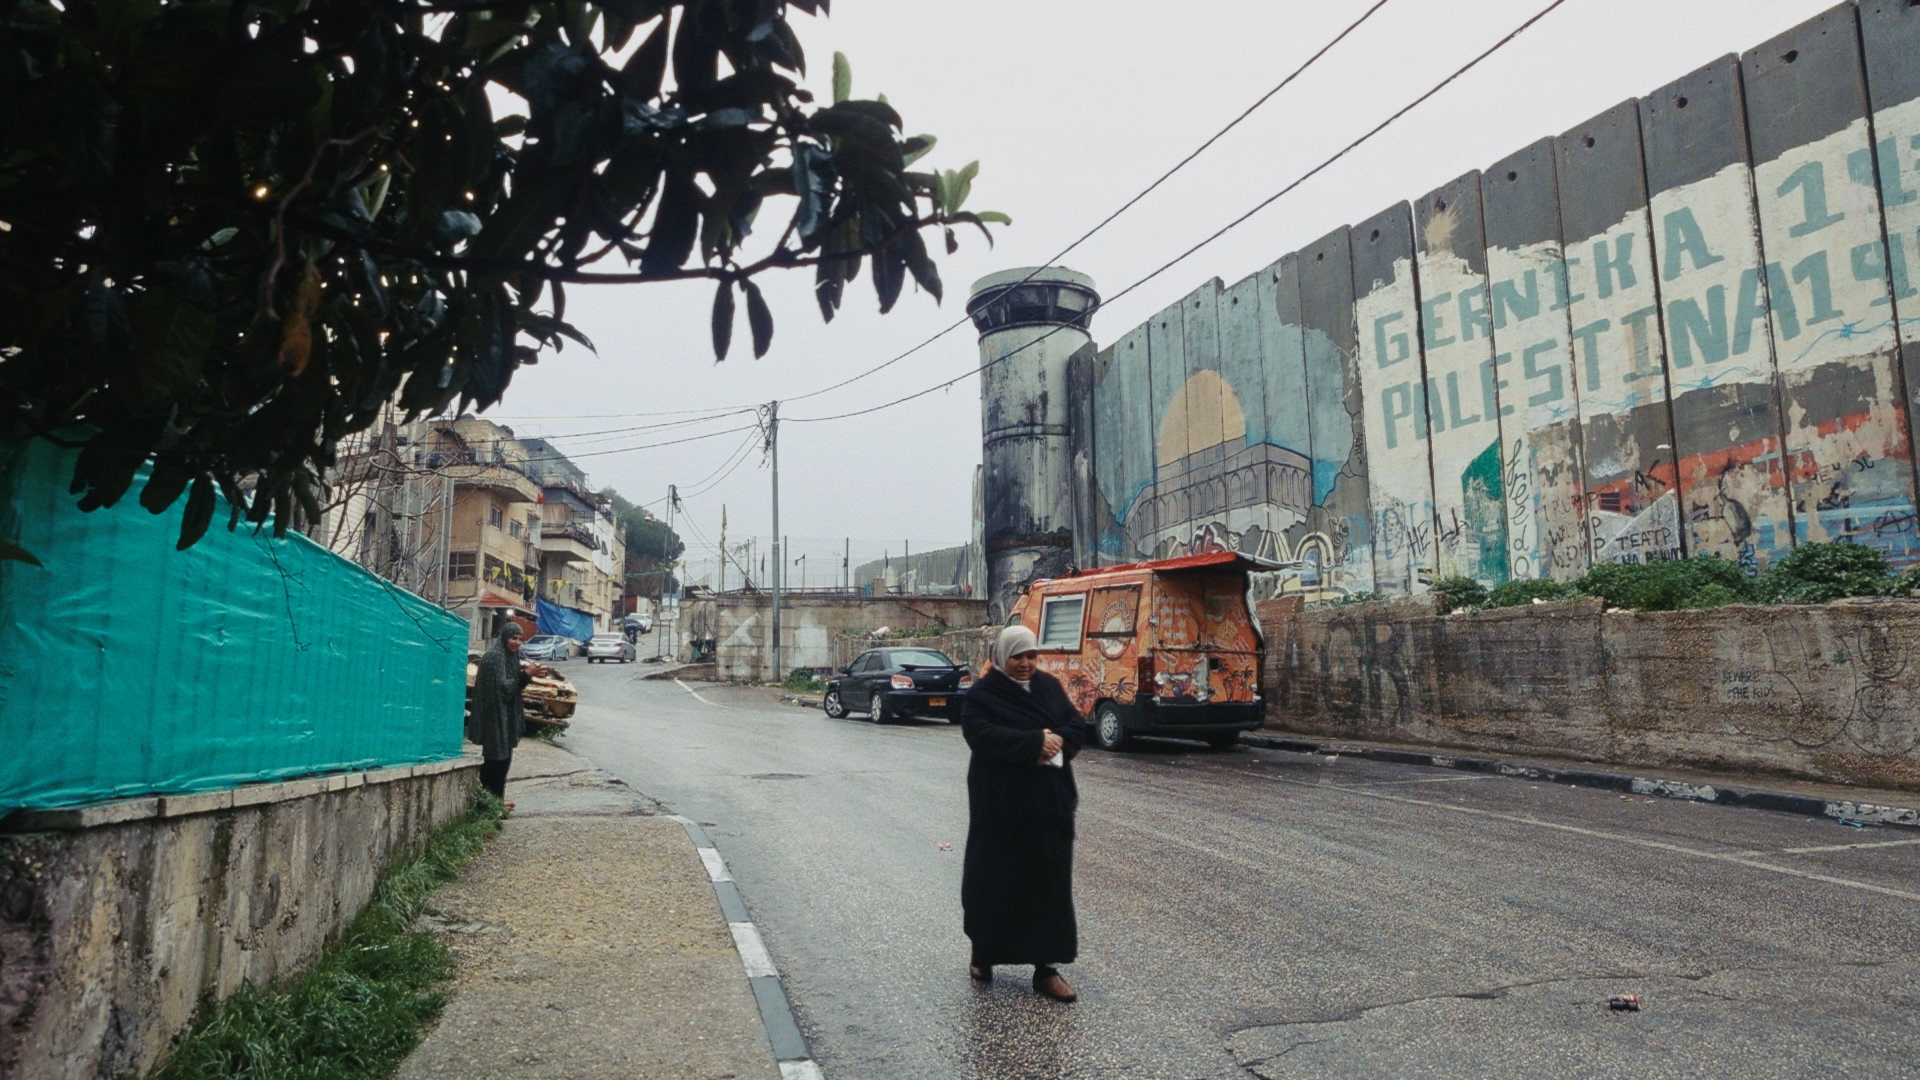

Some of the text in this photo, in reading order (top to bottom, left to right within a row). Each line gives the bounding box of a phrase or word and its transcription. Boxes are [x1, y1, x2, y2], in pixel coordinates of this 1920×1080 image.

[1373, 133, 1920, 369] GERNIKA 19
[1381, 225, 1920, 450] PALESTINA 19
[1535, 491, 1600, 523] TRUMP
[1728, 686, 1750, 699] THE
